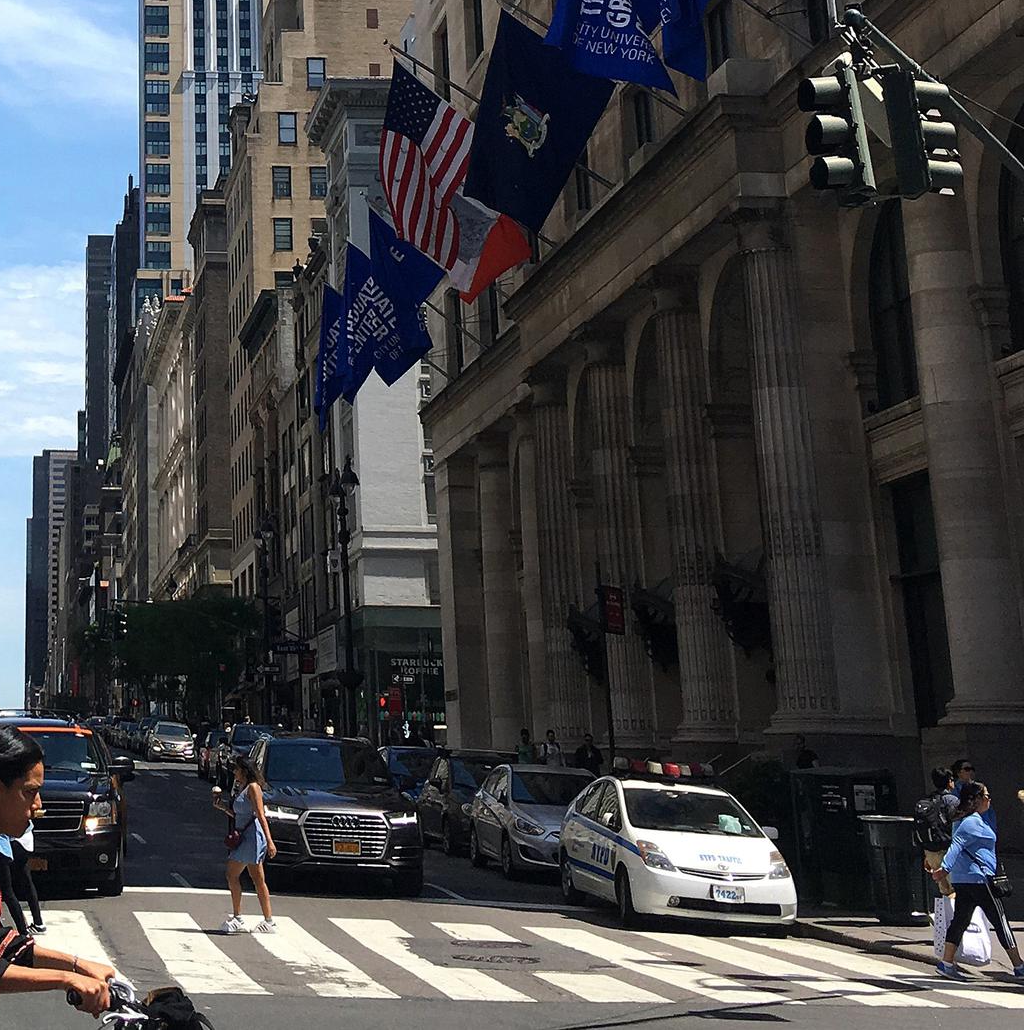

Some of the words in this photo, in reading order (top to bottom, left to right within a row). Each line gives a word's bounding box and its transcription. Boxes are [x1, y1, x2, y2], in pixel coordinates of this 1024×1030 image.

[585, 40, 617, 55] NEW
[620, 46, 655, 65] YORK
[591, 842, 610, 866] NYPD
[717, 855, 743, 864] TRAFFIC
[715, 889, 736, 900] 7422
